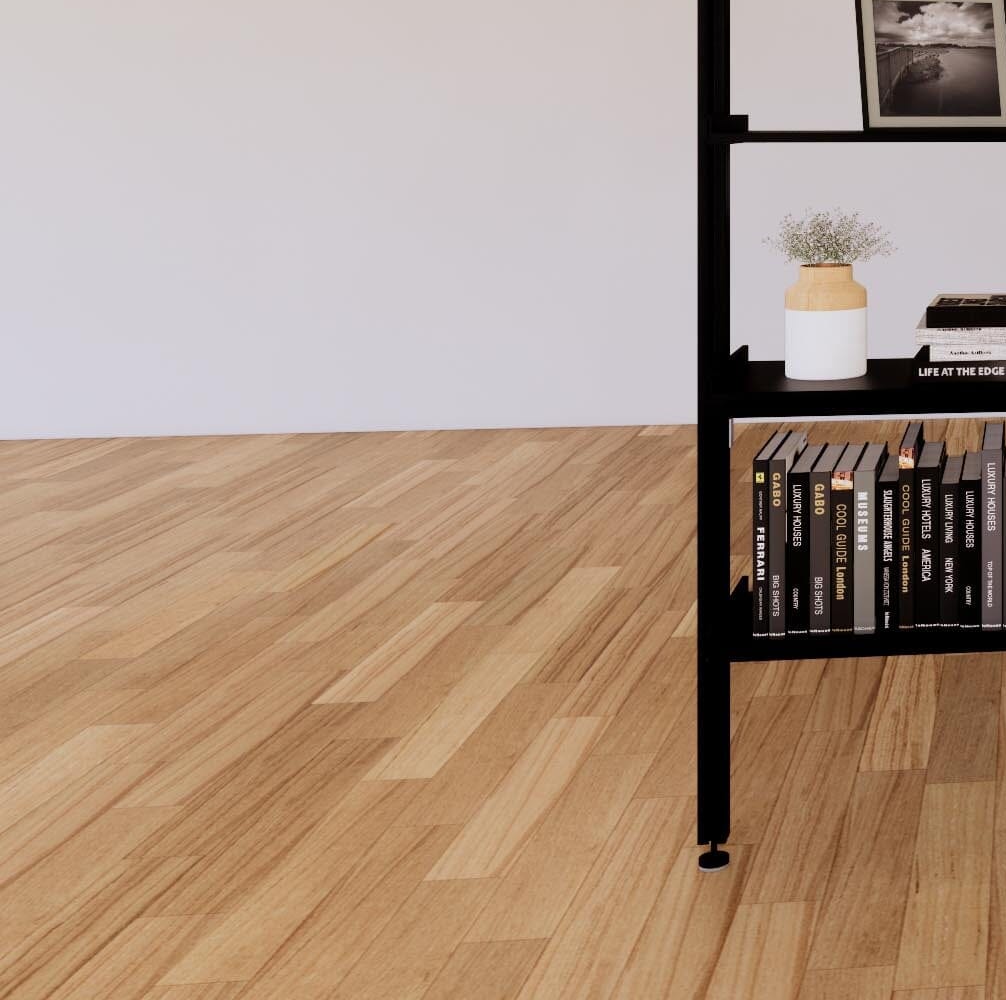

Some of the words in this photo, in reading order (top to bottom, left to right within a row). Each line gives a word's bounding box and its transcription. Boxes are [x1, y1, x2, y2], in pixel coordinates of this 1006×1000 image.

[919, 368, 939, 376] LIFE
[941, 368, 954, 376] AT
[956, 367, 976, 376] THE
[978, 367, 1005, 375] EDGE
[773, 473, 781, 506] GABO
[922, 479, 931, 508] LUXURY
[987, 463, 996, 495] LUXURY
[793, 485, 801, 514] LUXURY
[815, 484, 825, 515] GABO
[902, 485, 910, 514] COOL
[945, 495, 953, 520] LUXURY
[966, 491, 974, 517] LUXURY
[836, 504, 847, 531] COOL
[858, 492, 868, 550] MUSEUMS
[922, 510, 931, 539] HOTELS
[987, 498, 996, 531] HOUSES
[793, 516, 801, 546] HOUSES
[902, 519, 910, 551] GUIDE
[945, 522, 953, 543] LIVING
[966, 520, 974, 548] HOUSES
[757, 527, 765, 580] FERRARI
[836, 534, 847, 563] GUIDE
[922, 549, 931, 581] AMERICA
[945, 558, 953, 573] NEW
[772, 575, 780, 588] BIG
[815, 577, 823, 589] BIG
[836, 567, 846, 600] London
[945, 575, 953, 592] YORK
[772, 590, 780, 616] SHOTS
[815, 591, 823, 614] SHOTS
